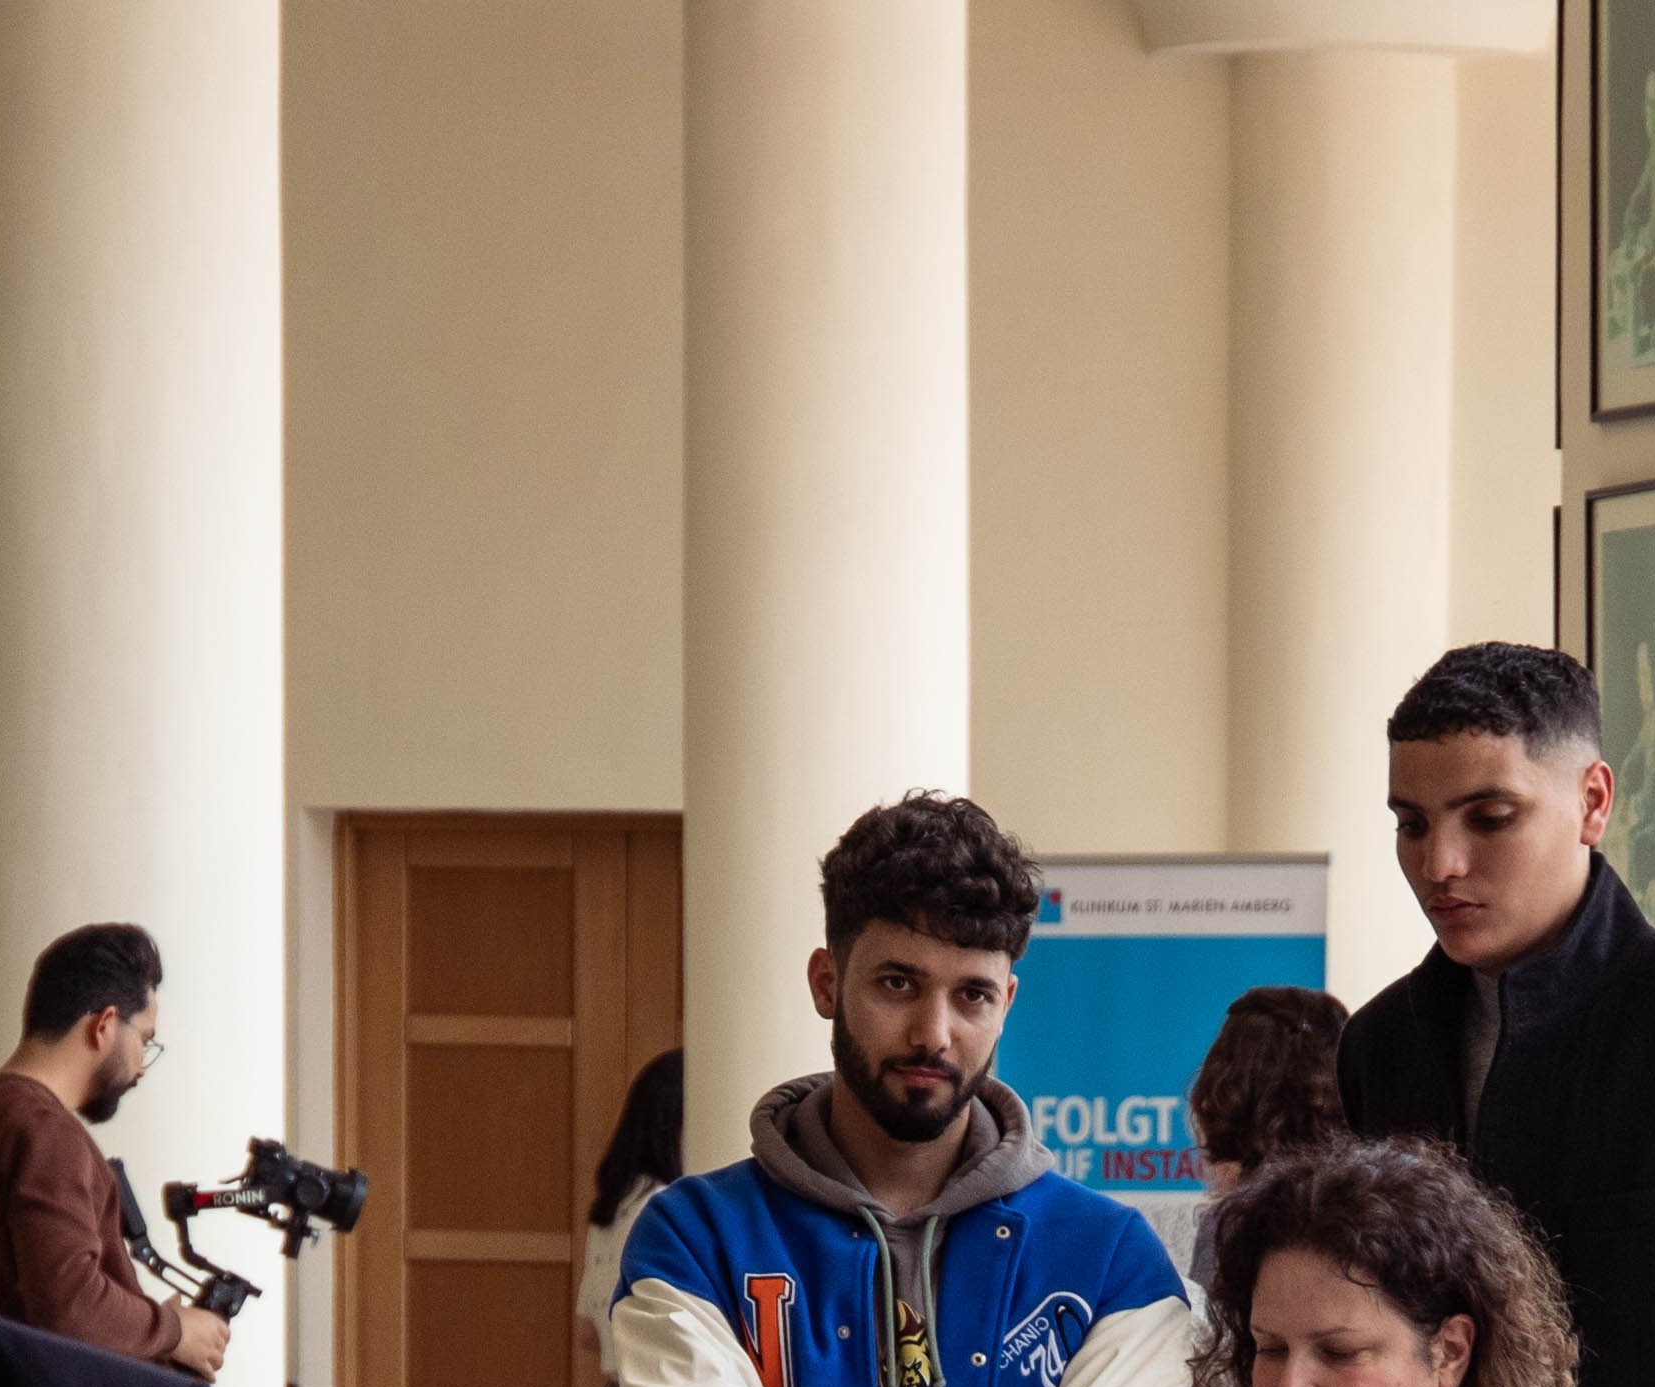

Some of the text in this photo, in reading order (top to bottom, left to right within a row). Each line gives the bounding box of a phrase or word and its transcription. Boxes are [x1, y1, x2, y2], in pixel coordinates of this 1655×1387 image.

[1070, 899, 1140, 913] KLINIKUM
[1168, 898, 1225, 913] MARIEN
[1229, 898, 1291, 913] AMBERG
[1032, 1095, 1178, 1145] FOLGT
[1053, 1148, 1093, 1181] UF
[213, 1188, 266, 1207] RONIN
